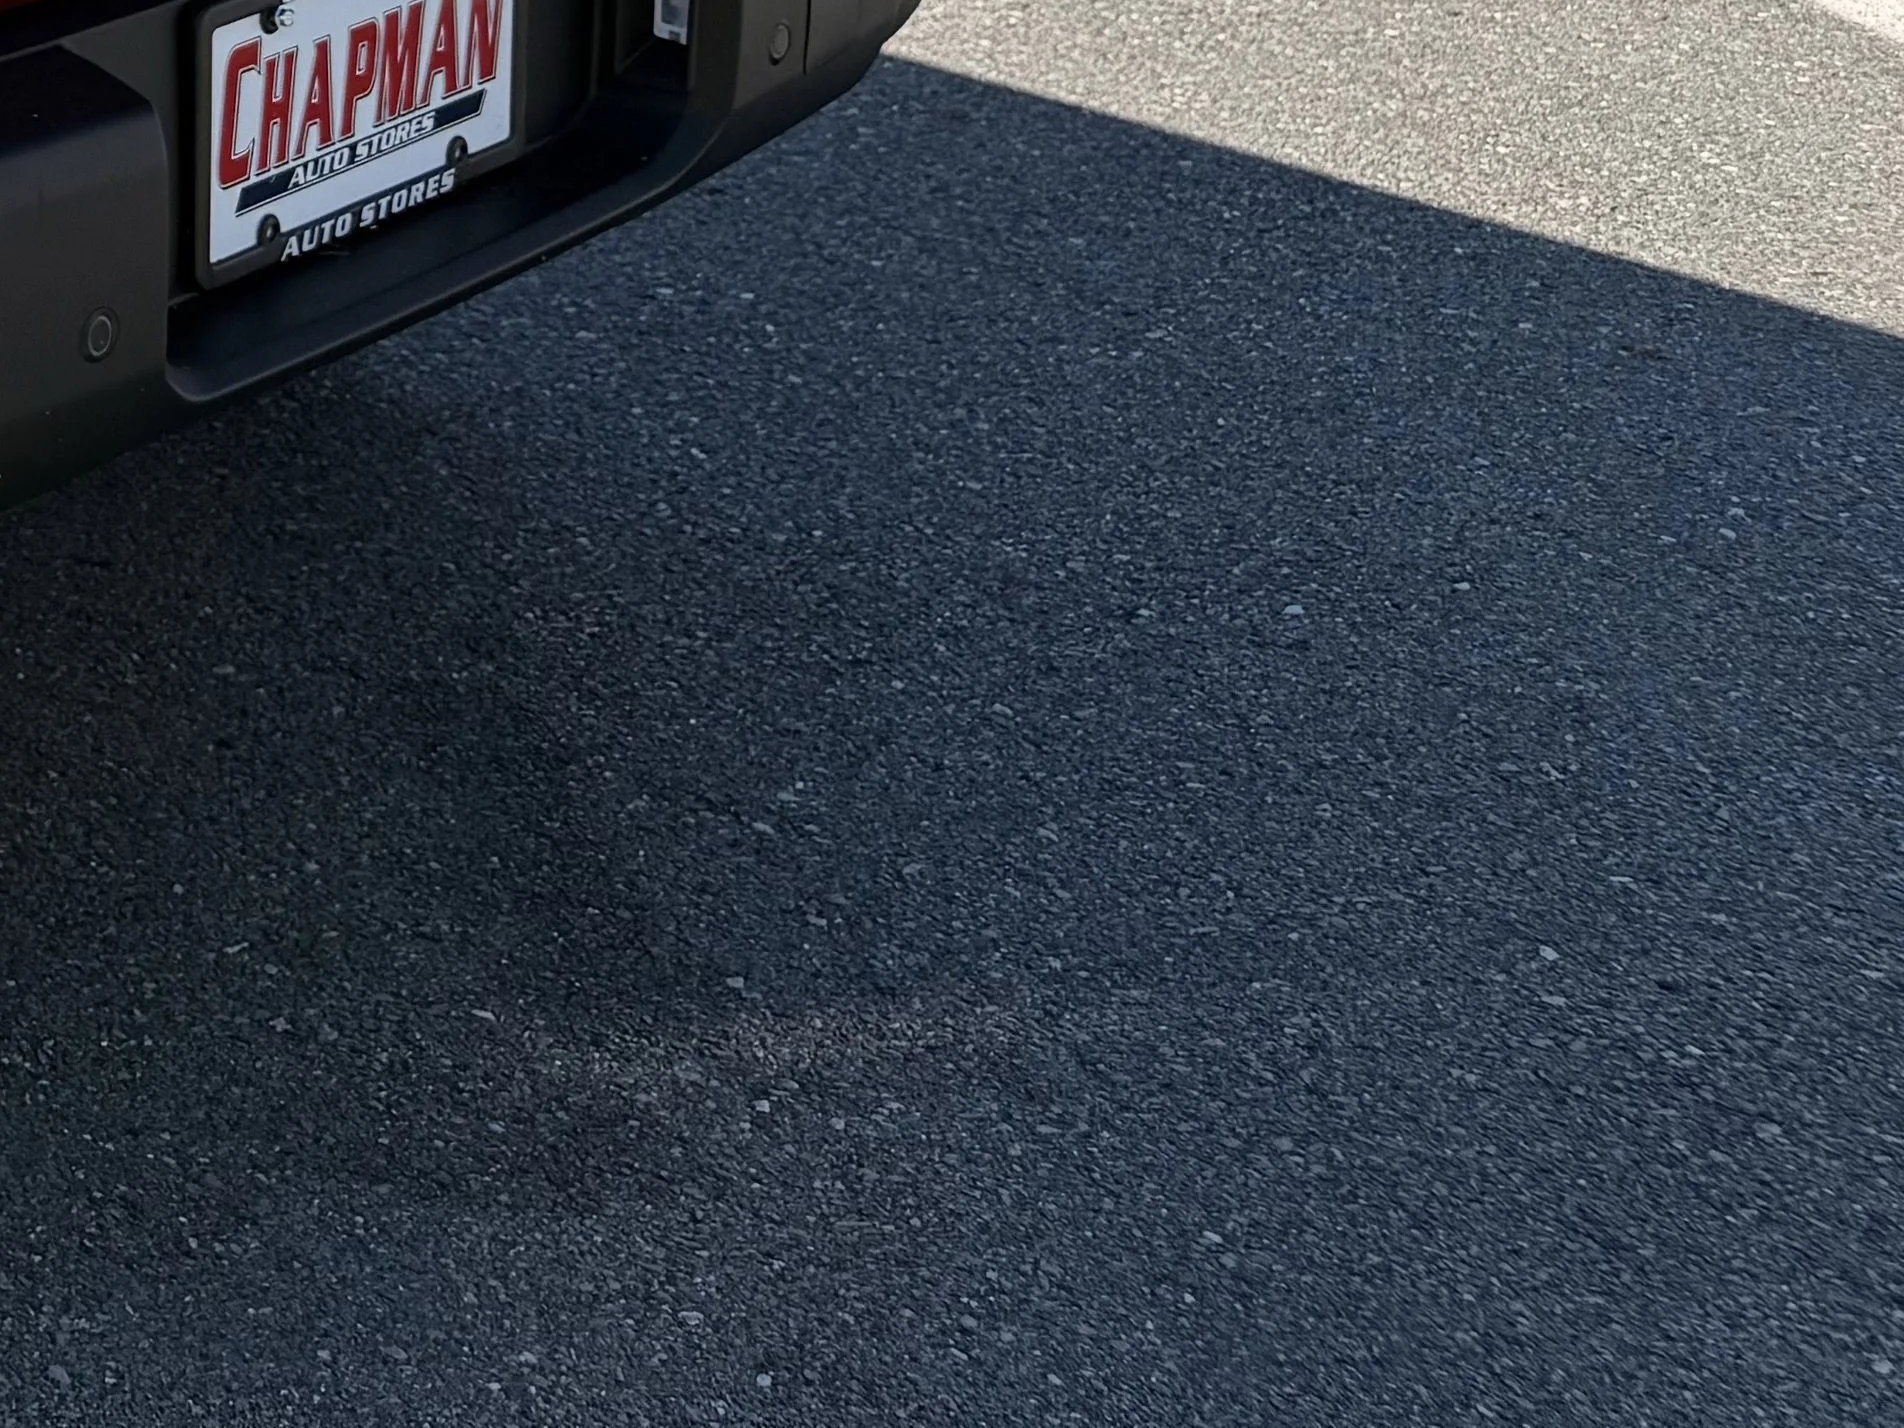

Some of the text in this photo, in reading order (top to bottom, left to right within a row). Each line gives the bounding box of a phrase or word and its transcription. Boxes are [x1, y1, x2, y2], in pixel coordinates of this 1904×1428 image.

[288, 112, 436, 189] AUTO STORES
[281, 168, 457, 262] AUTO STORES
